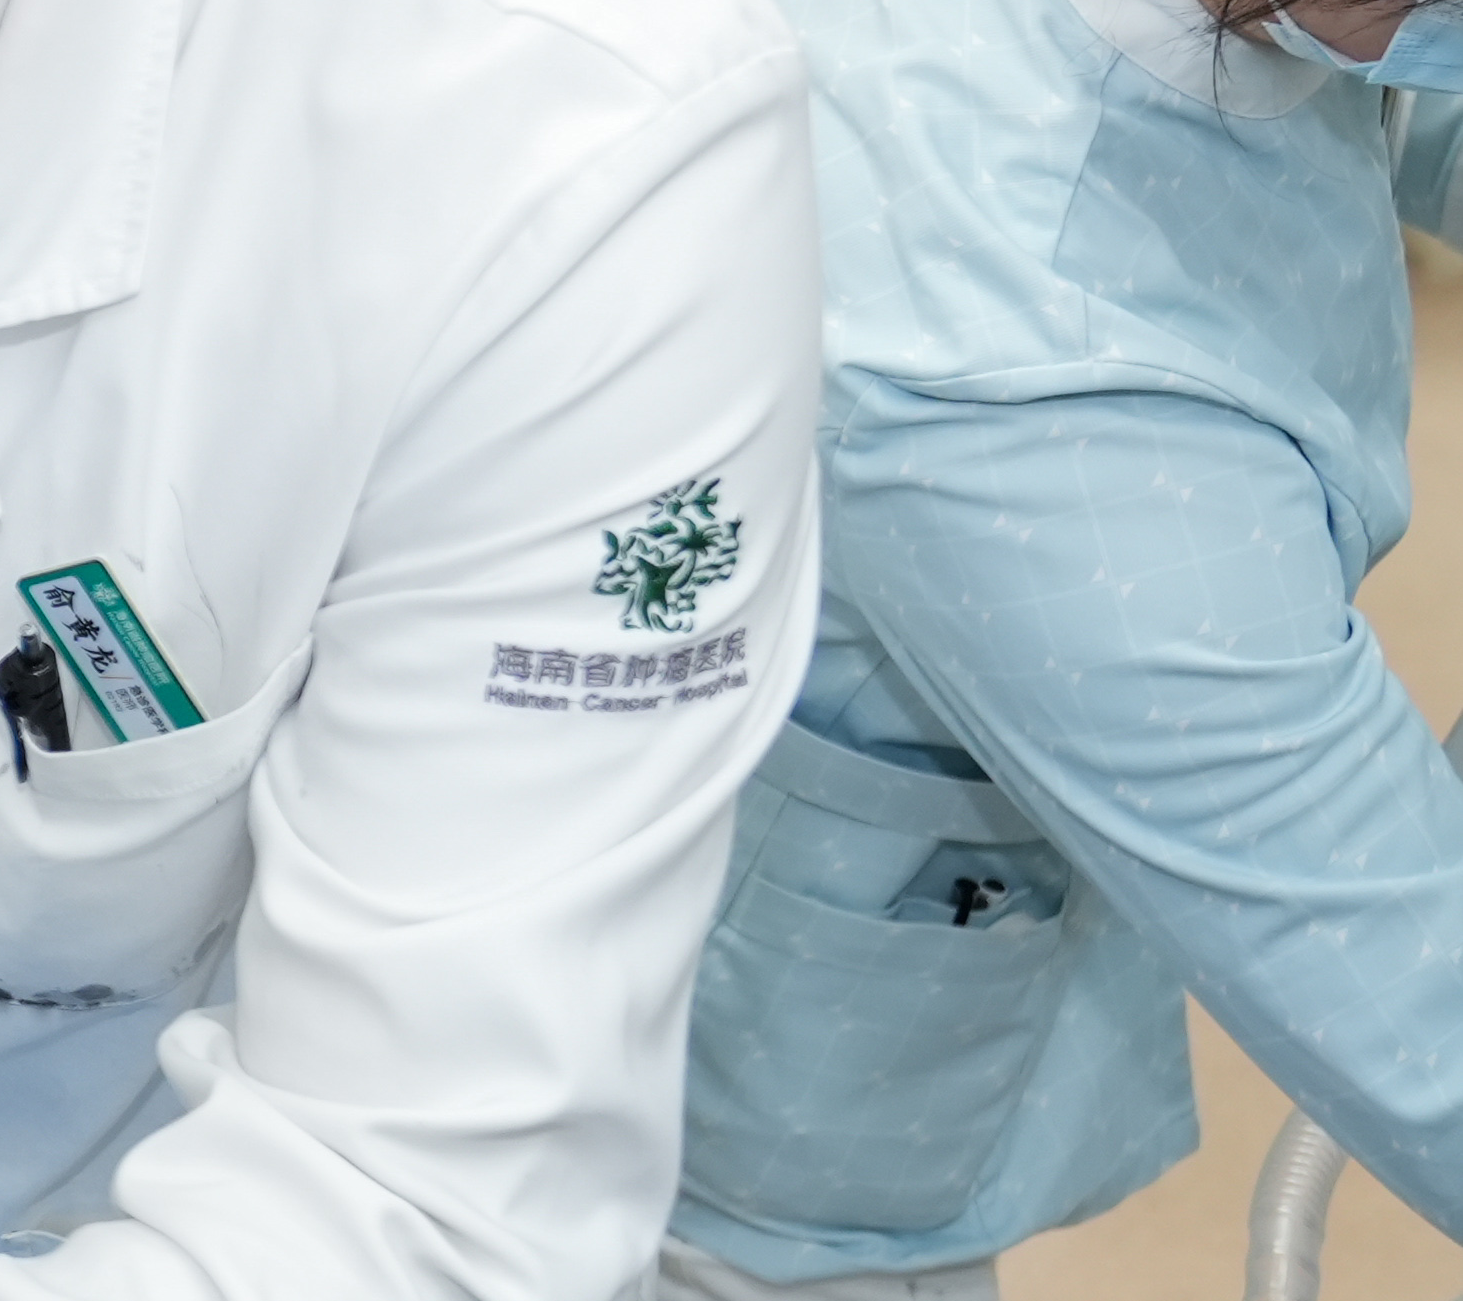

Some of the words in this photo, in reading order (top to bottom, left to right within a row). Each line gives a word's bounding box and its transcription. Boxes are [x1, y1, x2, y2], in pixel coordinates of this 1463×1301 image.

[489, 627, 746, 687] 海南省肿瘤医院
[485, 684, 569, 710] Hainan
[581, 693, 661, 712] Cancer
[673, 668, 749, 705] Hospital
